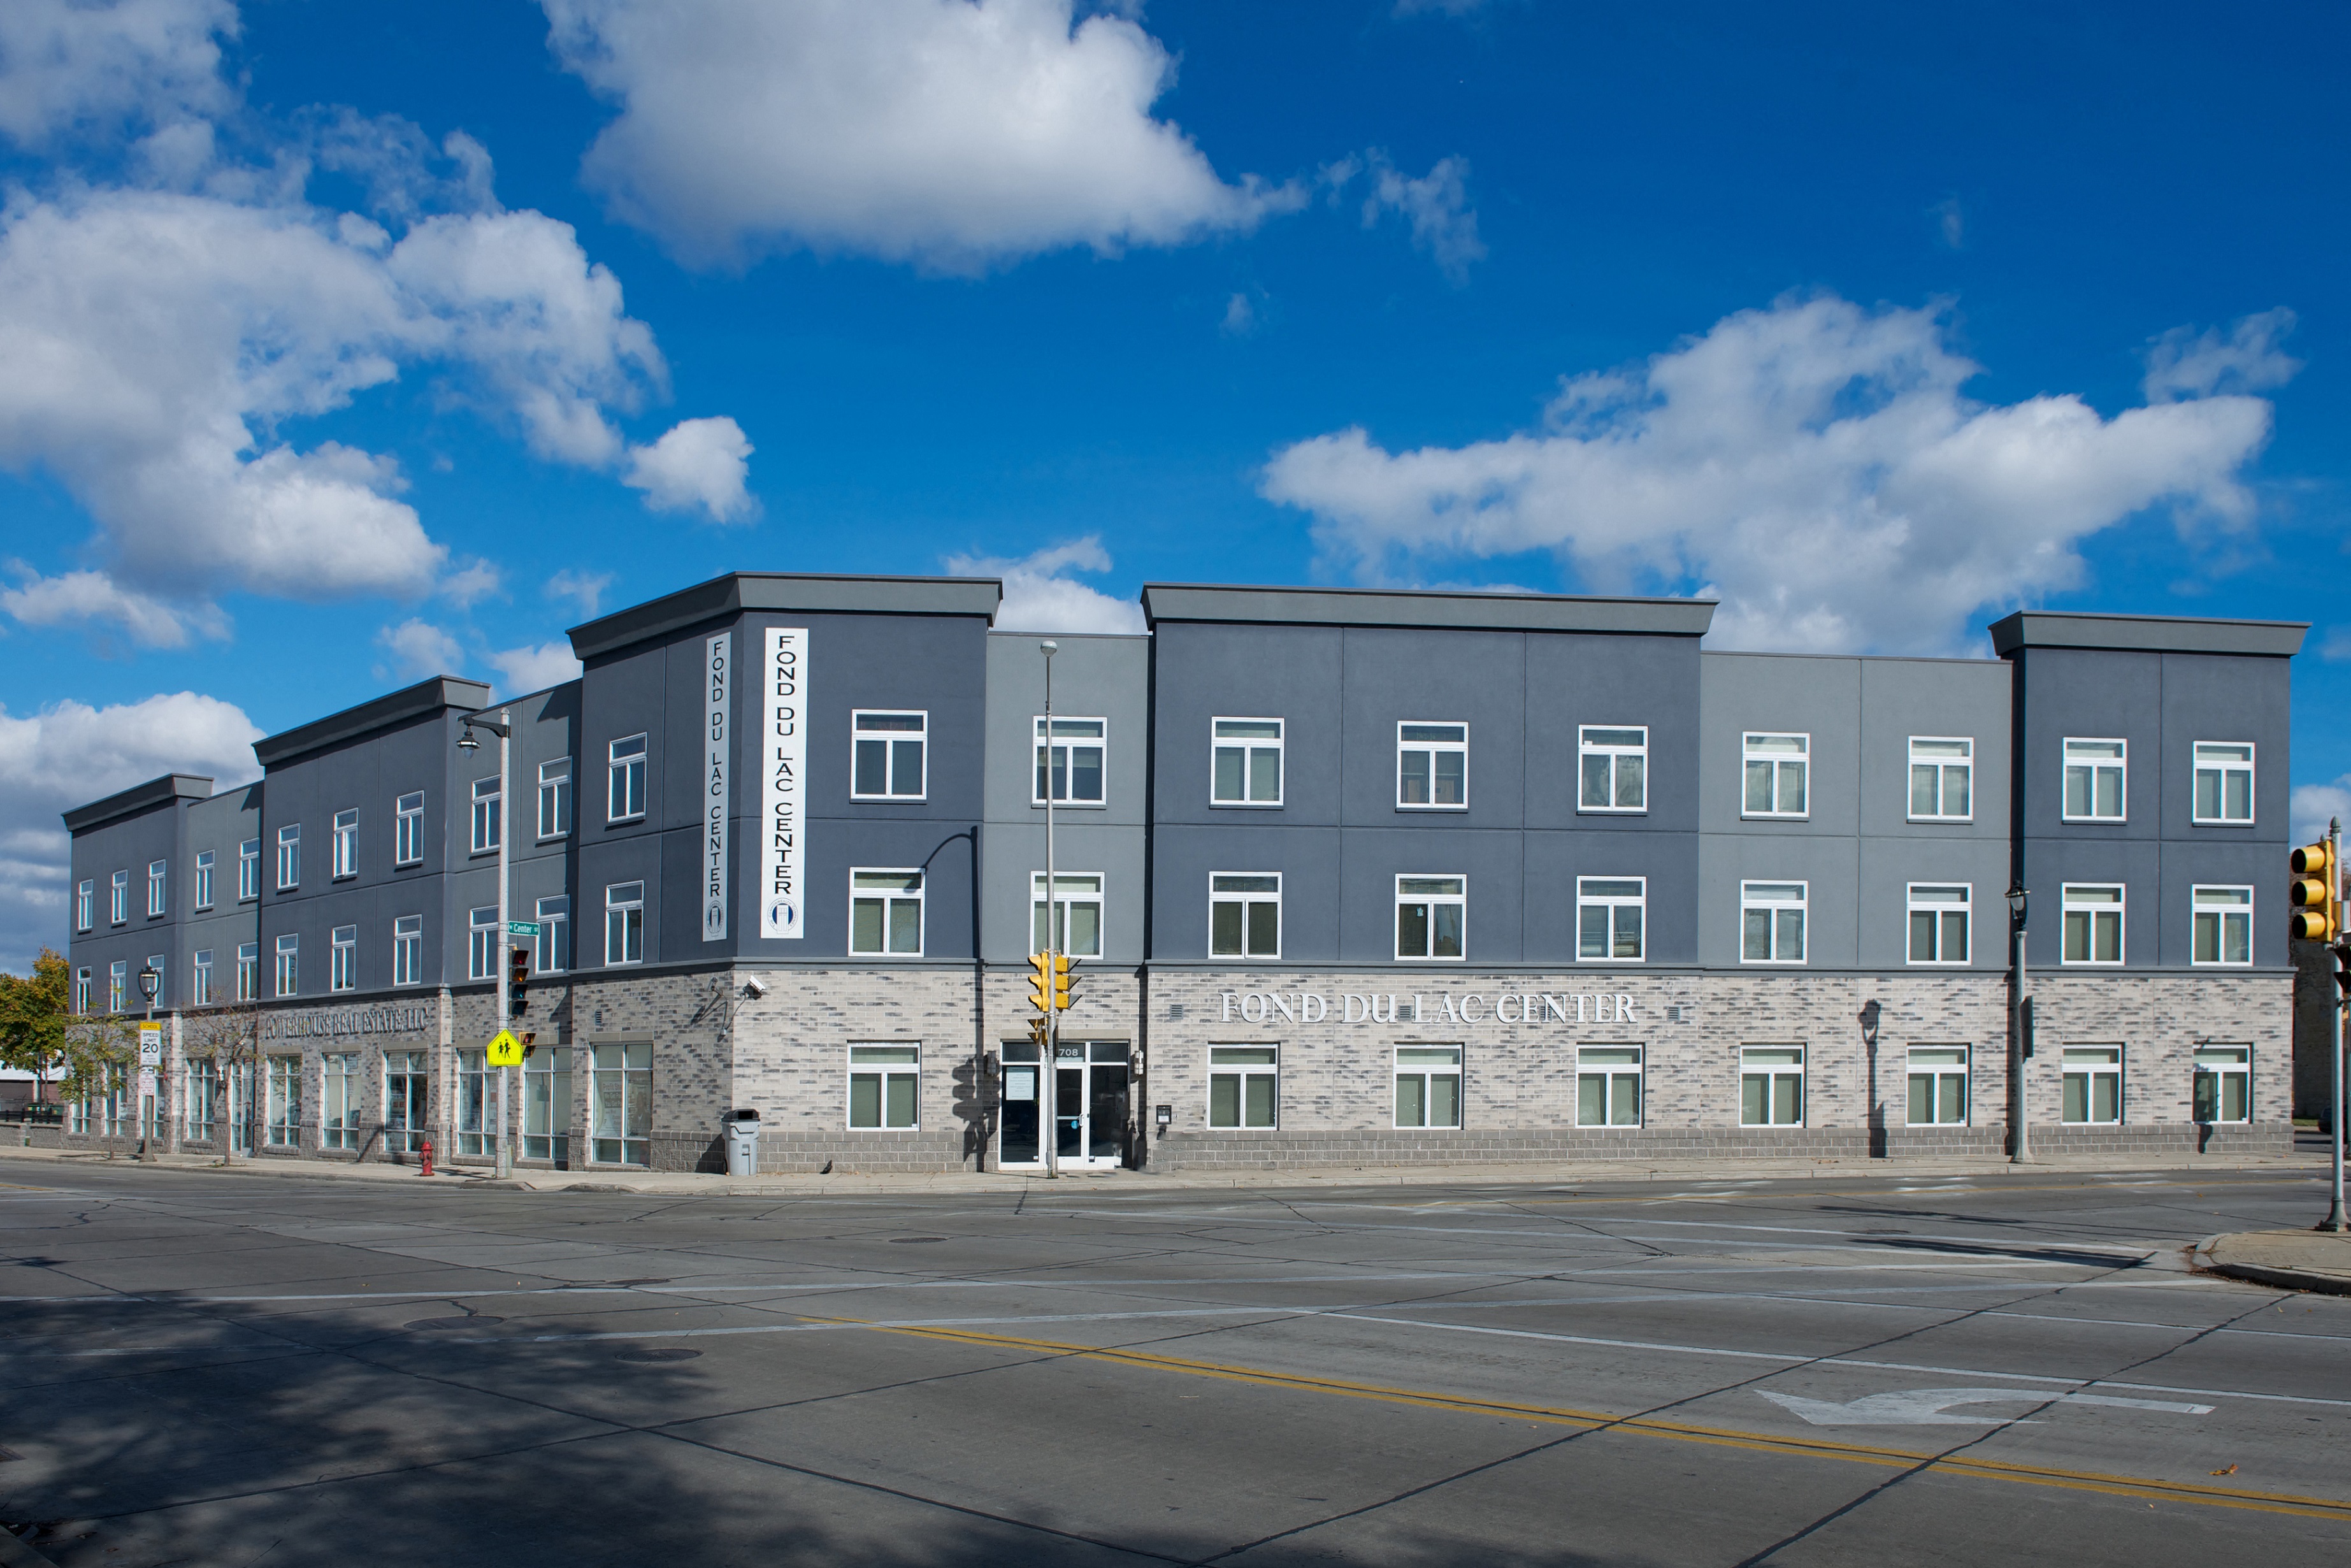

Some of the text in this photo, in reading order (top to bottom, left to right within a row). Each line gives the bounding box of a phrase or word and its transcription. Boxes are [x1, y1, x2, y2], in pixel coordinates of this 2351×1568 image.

[712, 640, 724, 703] FOND
[711, 711, 724, 742] DU
[710, 752, 723, 797] LAC
[773, 635, 796, 895] FOND DU LAC CENTER
[709, 805, 722, 898] CENTER
[514, 923, 532, 933] Center
[265, 1007, 429, 1040] POWERHOUSE REAL ESTATE, LLC
[1218, 992, 1639, 1024] FOND DU LAC CENTER
[142, 1043, 159, 1053] 20
